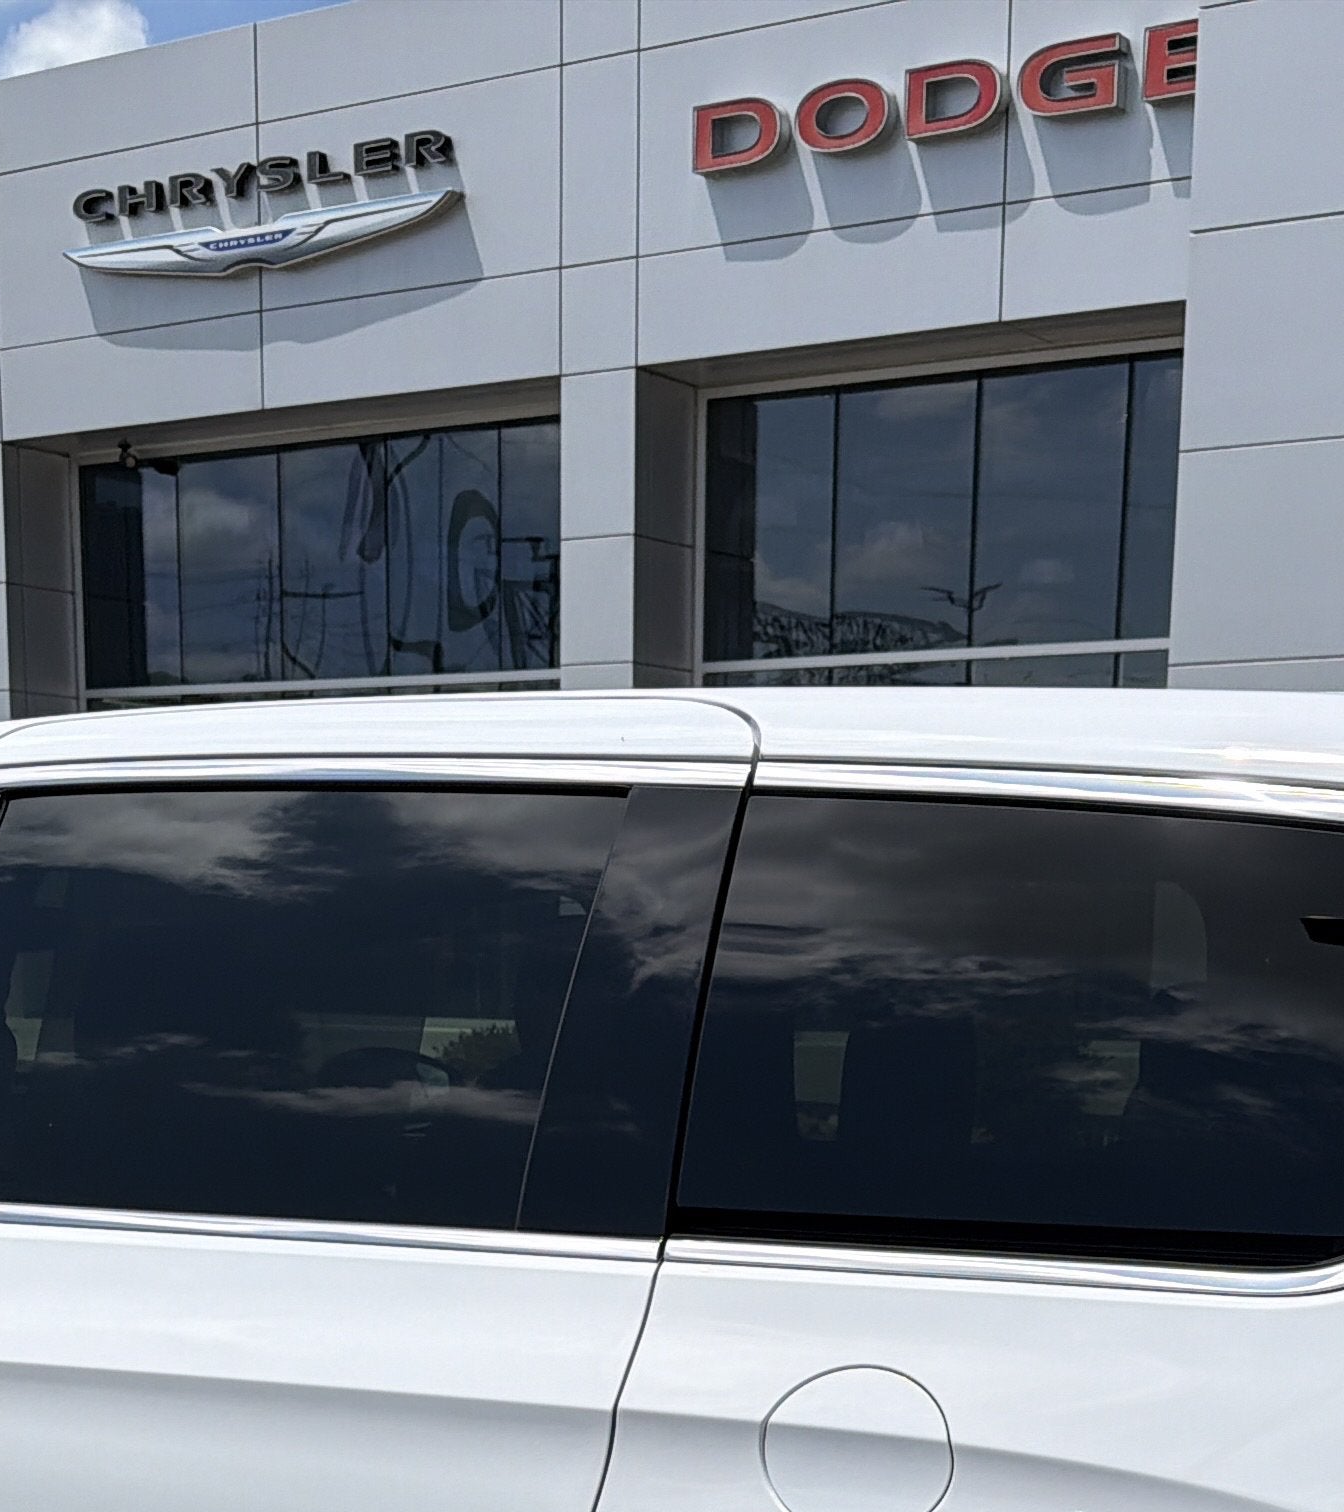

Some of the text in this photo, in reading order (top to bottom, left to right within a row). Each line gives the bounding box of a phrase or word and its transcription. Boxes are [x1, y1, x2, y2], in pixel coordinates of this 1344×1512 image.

[692, 18, 1199, 175] DODGE
[73, 129, 456, 223] CHRYSLER
[209, 233, 283, 250] CHRYSLER
